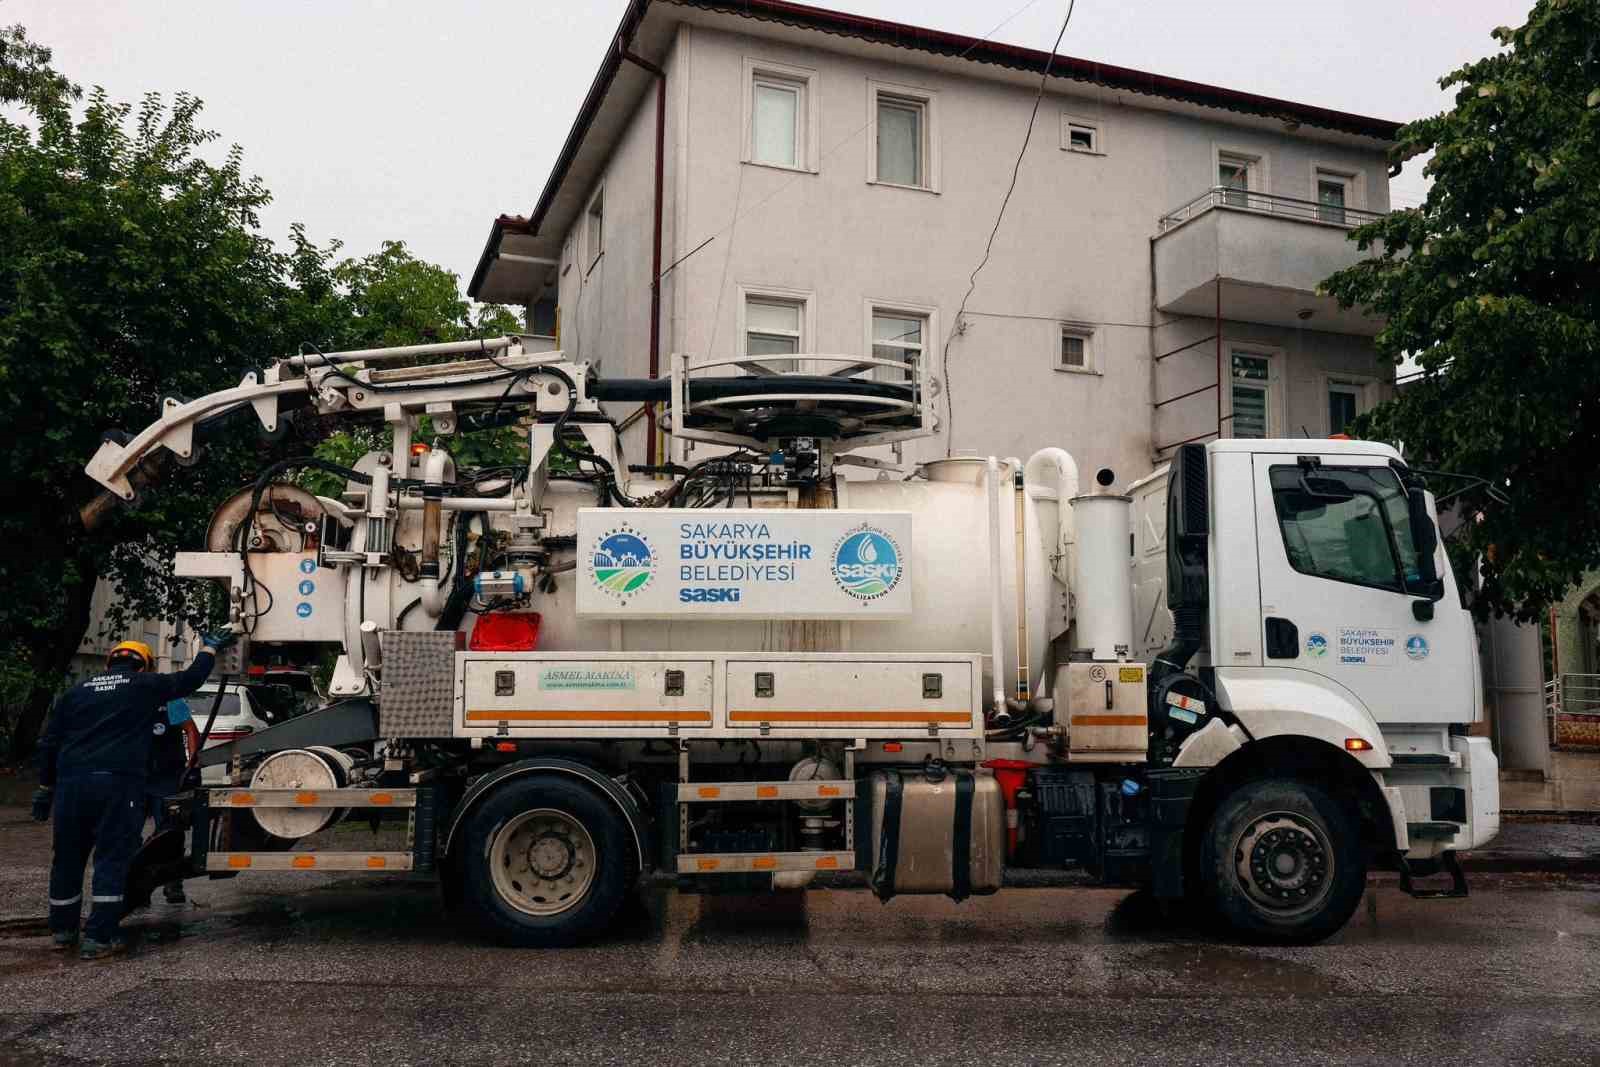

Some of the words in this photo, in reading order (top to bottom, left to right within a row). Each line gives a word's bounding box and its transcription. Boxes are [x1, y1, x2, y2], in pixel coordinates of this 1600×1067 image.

[680, 523, 770, 539] SAKARYA
[680, 540, 811, 561] BÜYÜKŞEHİR
[680, 562, 795, 581] BELEDİYESİ
[1340, 629, 1378, 638] SAKARYA
